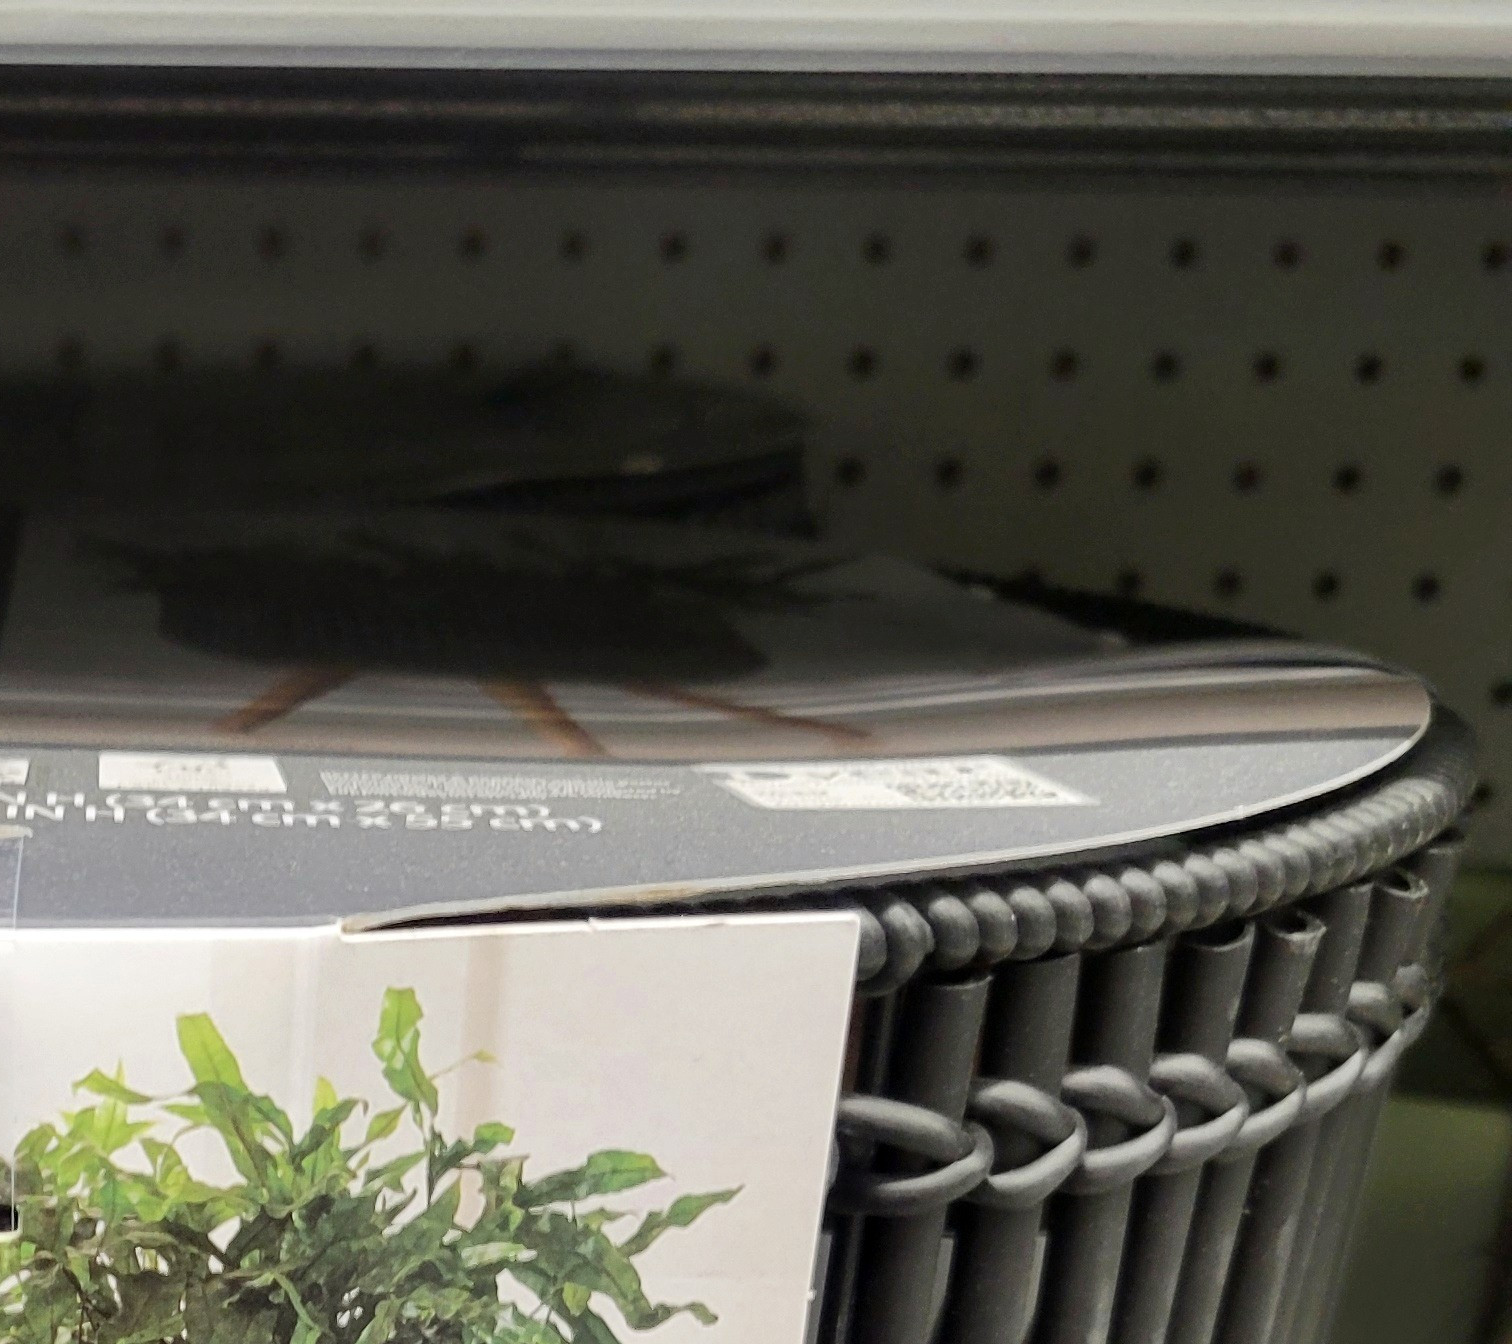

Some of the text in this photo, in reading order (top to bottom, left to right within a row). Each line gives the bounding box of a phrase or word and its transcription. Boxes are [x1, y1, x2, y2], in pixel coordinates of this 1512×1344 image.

[46, 791, 84, 807] H
[7, 804, 63, 821] IN
[86, 804, 124, 823] H
